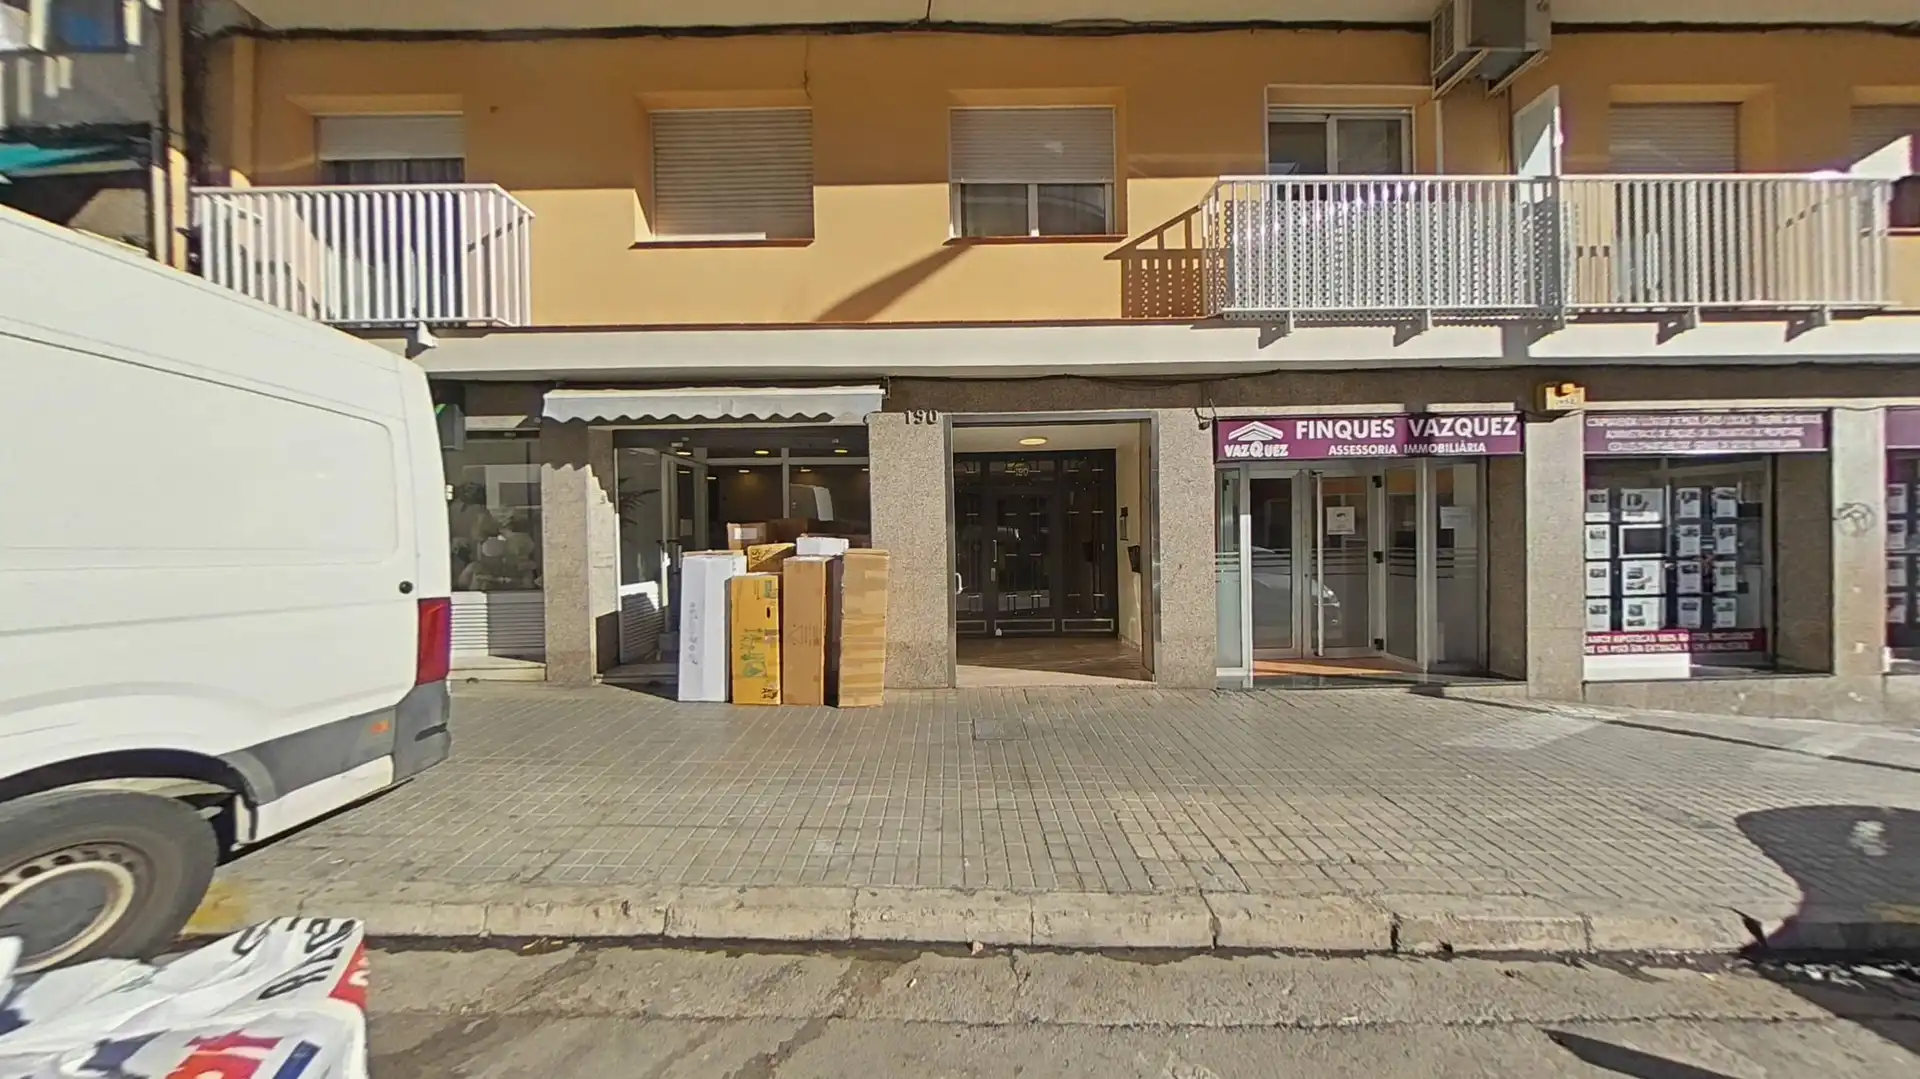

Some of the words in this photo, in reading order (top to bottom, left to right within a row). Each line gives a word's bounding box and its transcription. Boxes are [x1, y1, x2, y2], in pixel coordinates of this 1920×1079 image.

[905, 409, 938, 425] 190
[1295, 419, 1395, 440] FINQUES
[1408, 416, 1517, 437] VAZQUEZ
[1224, 440, 1289, 457] VAZQUEZ
[1328, 444, 1397, 456] ASSESSORIA
